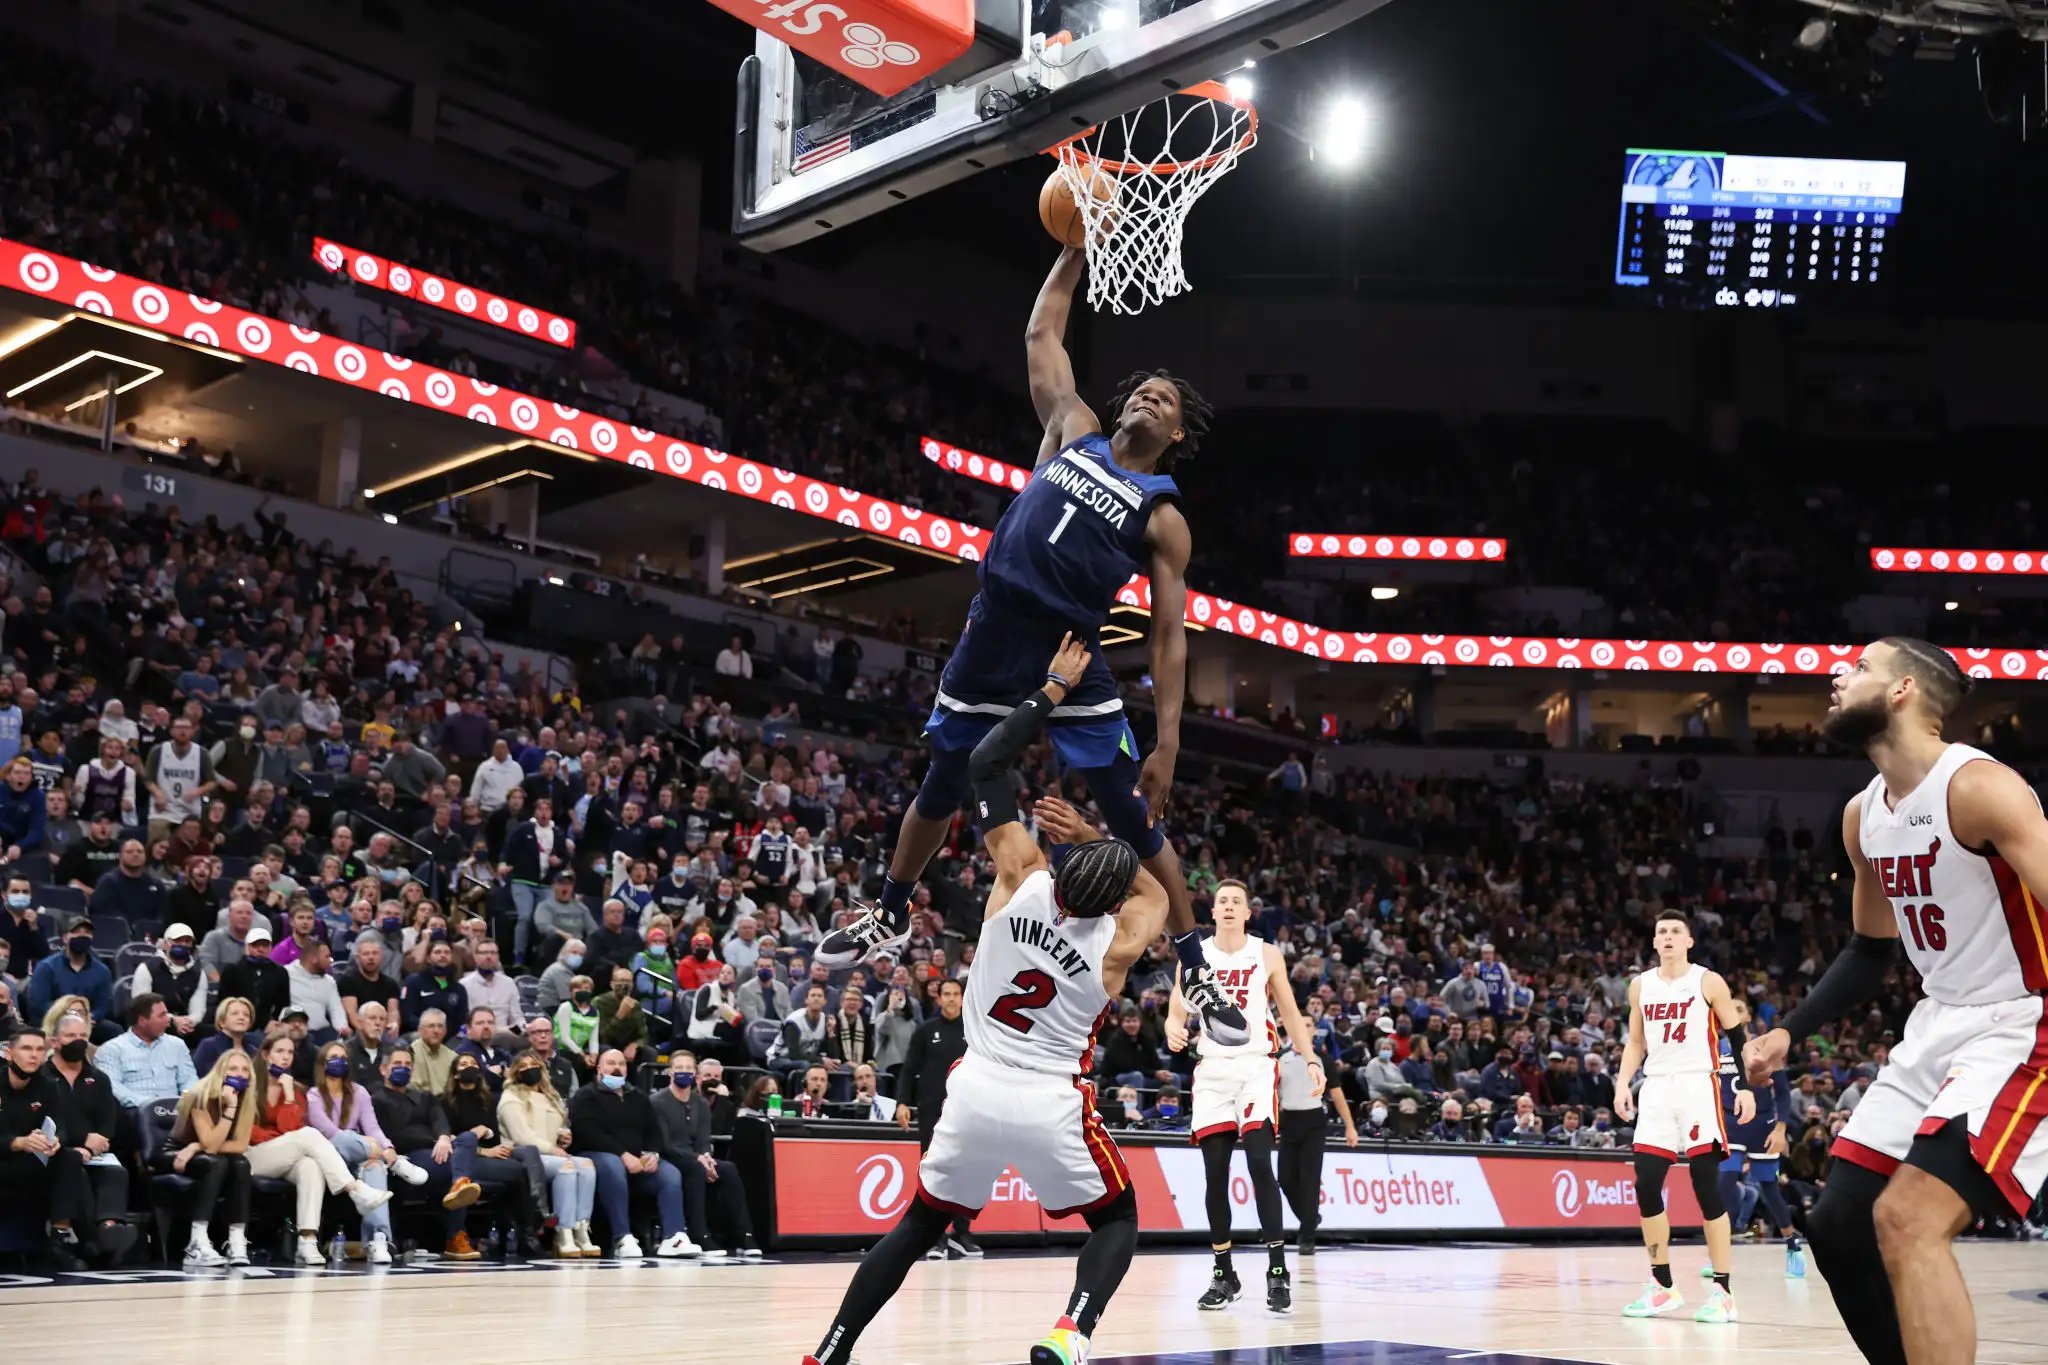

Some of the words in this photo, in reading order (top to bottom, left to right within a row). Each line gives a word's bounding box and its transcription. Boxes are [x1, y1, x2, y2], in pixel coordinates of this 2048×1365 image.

[754, 0, 848, 35] St
[143, 473, 176, 496] 131
[1041, 460, 1129, 530] MINNESOTA
[1047, 501, 1078, 545] 1
[173, 782, 183, 798] 9
[1909, 815, 1932, 827] UKG
[1903, 903, 1947, 951] 16
[1009, 916, 1091, 978] VINCENT
[1216, 963, 1258, 987] EAT
[987, 968, 1058, 1035] 2
[1225, 989, 1249, 1011] 5
[1644, 996, 1695, 1021] HEAT
[1663, 1022, 1687, 1043] 14
[1335, 1167, 1461, 1214] Together.
